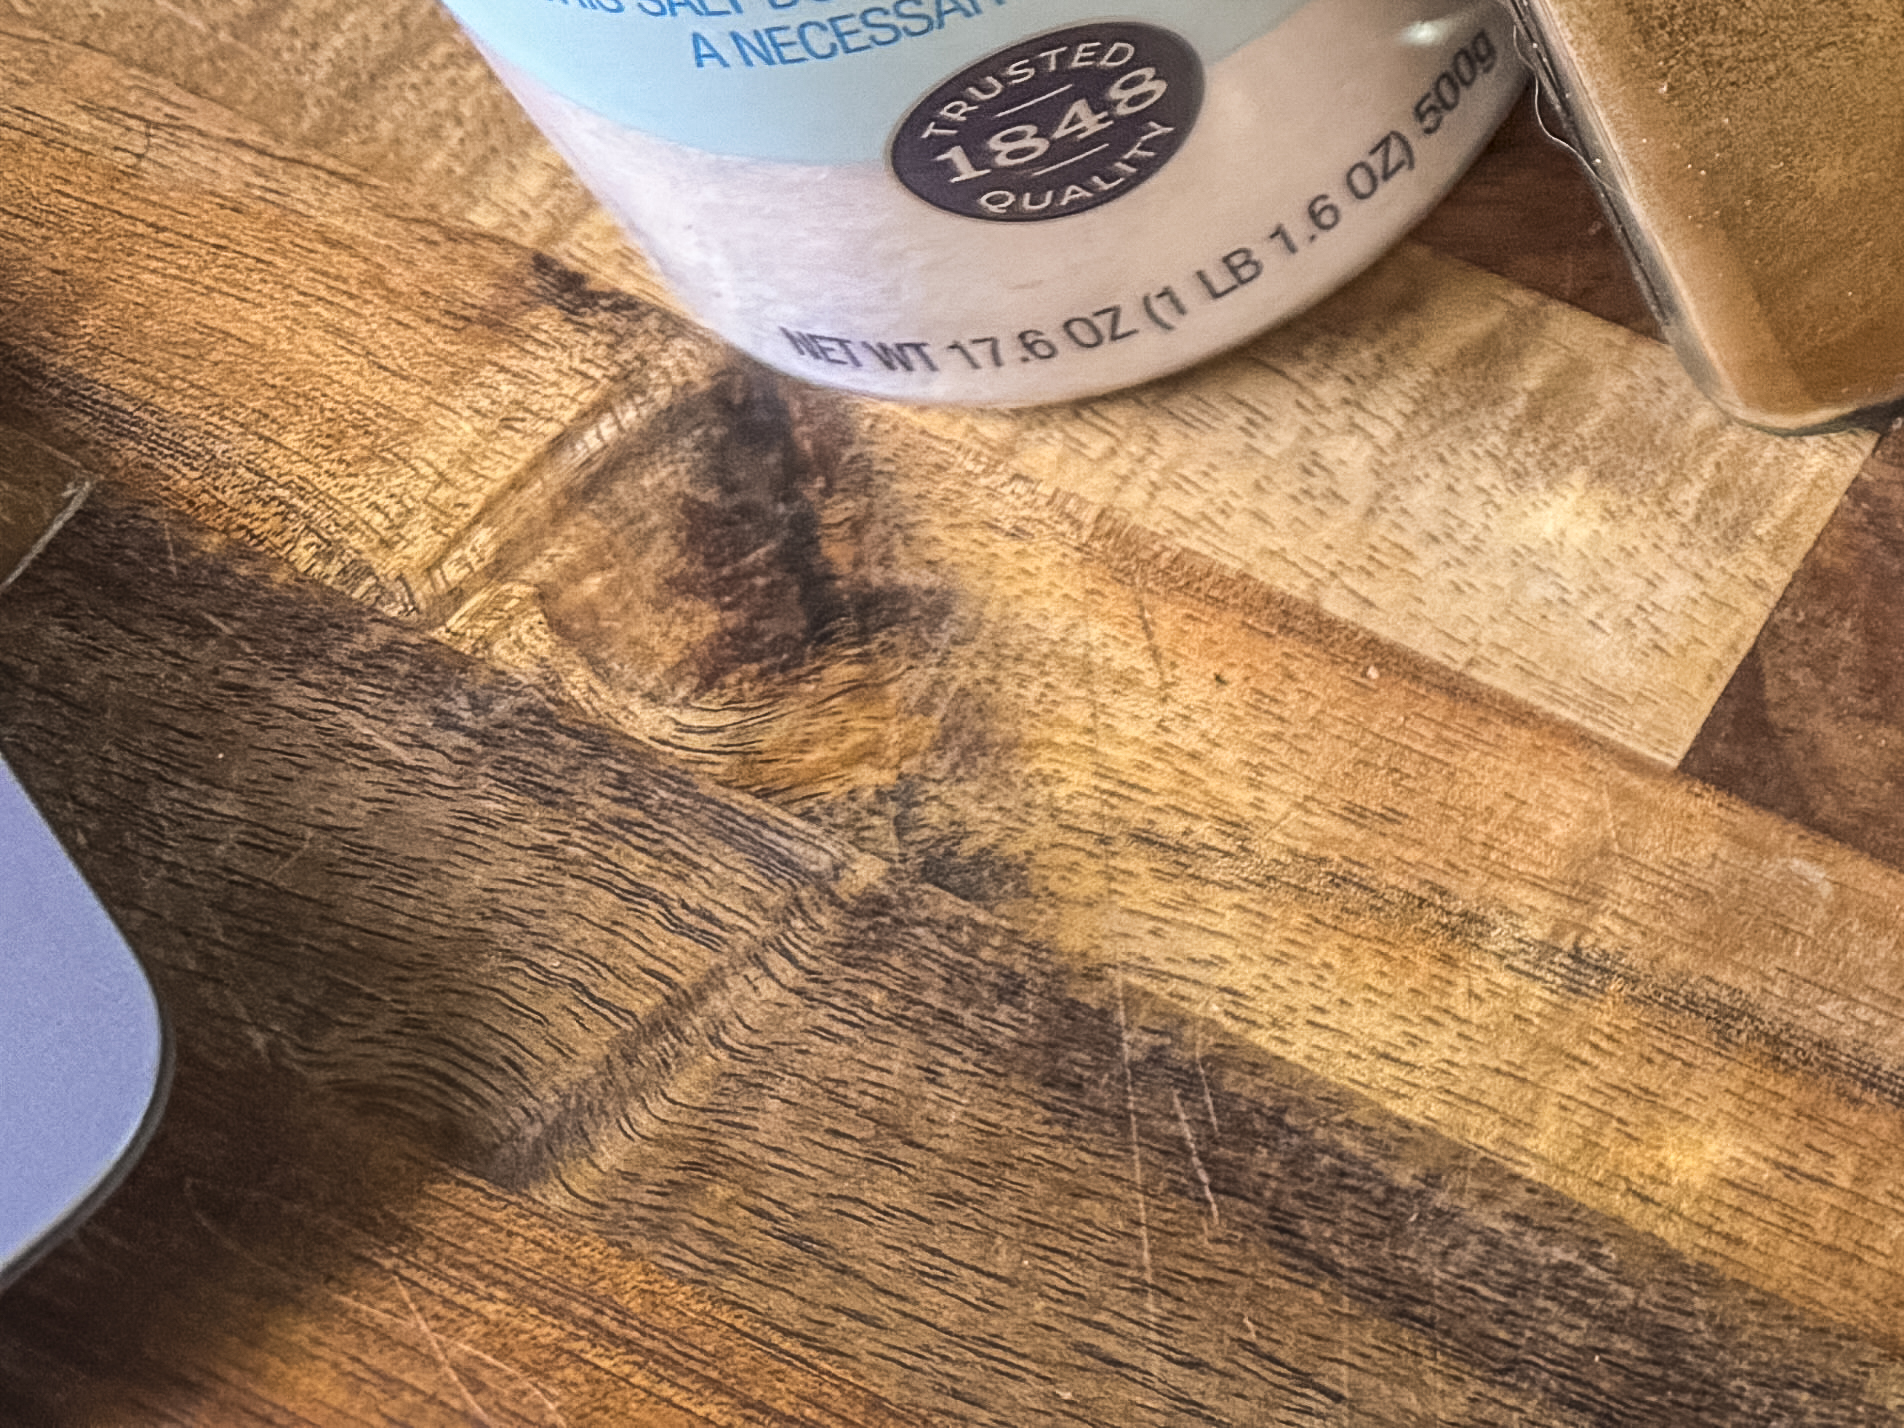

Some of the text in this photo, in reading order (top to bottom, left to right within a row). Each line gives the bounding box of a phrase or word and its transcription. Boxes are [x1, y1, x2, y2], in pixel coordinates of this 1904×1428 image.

[691, 31, 731, 69] A
[920, 40, 1136, 140] TRUSTED
[931, 65, 1169, 185] 1848
[979, 120, 1177, 215] QUALITY
[778, 27, 1499, 372] NET WT 17.6 OZ (1 LB 1.6 OZ) 500g
